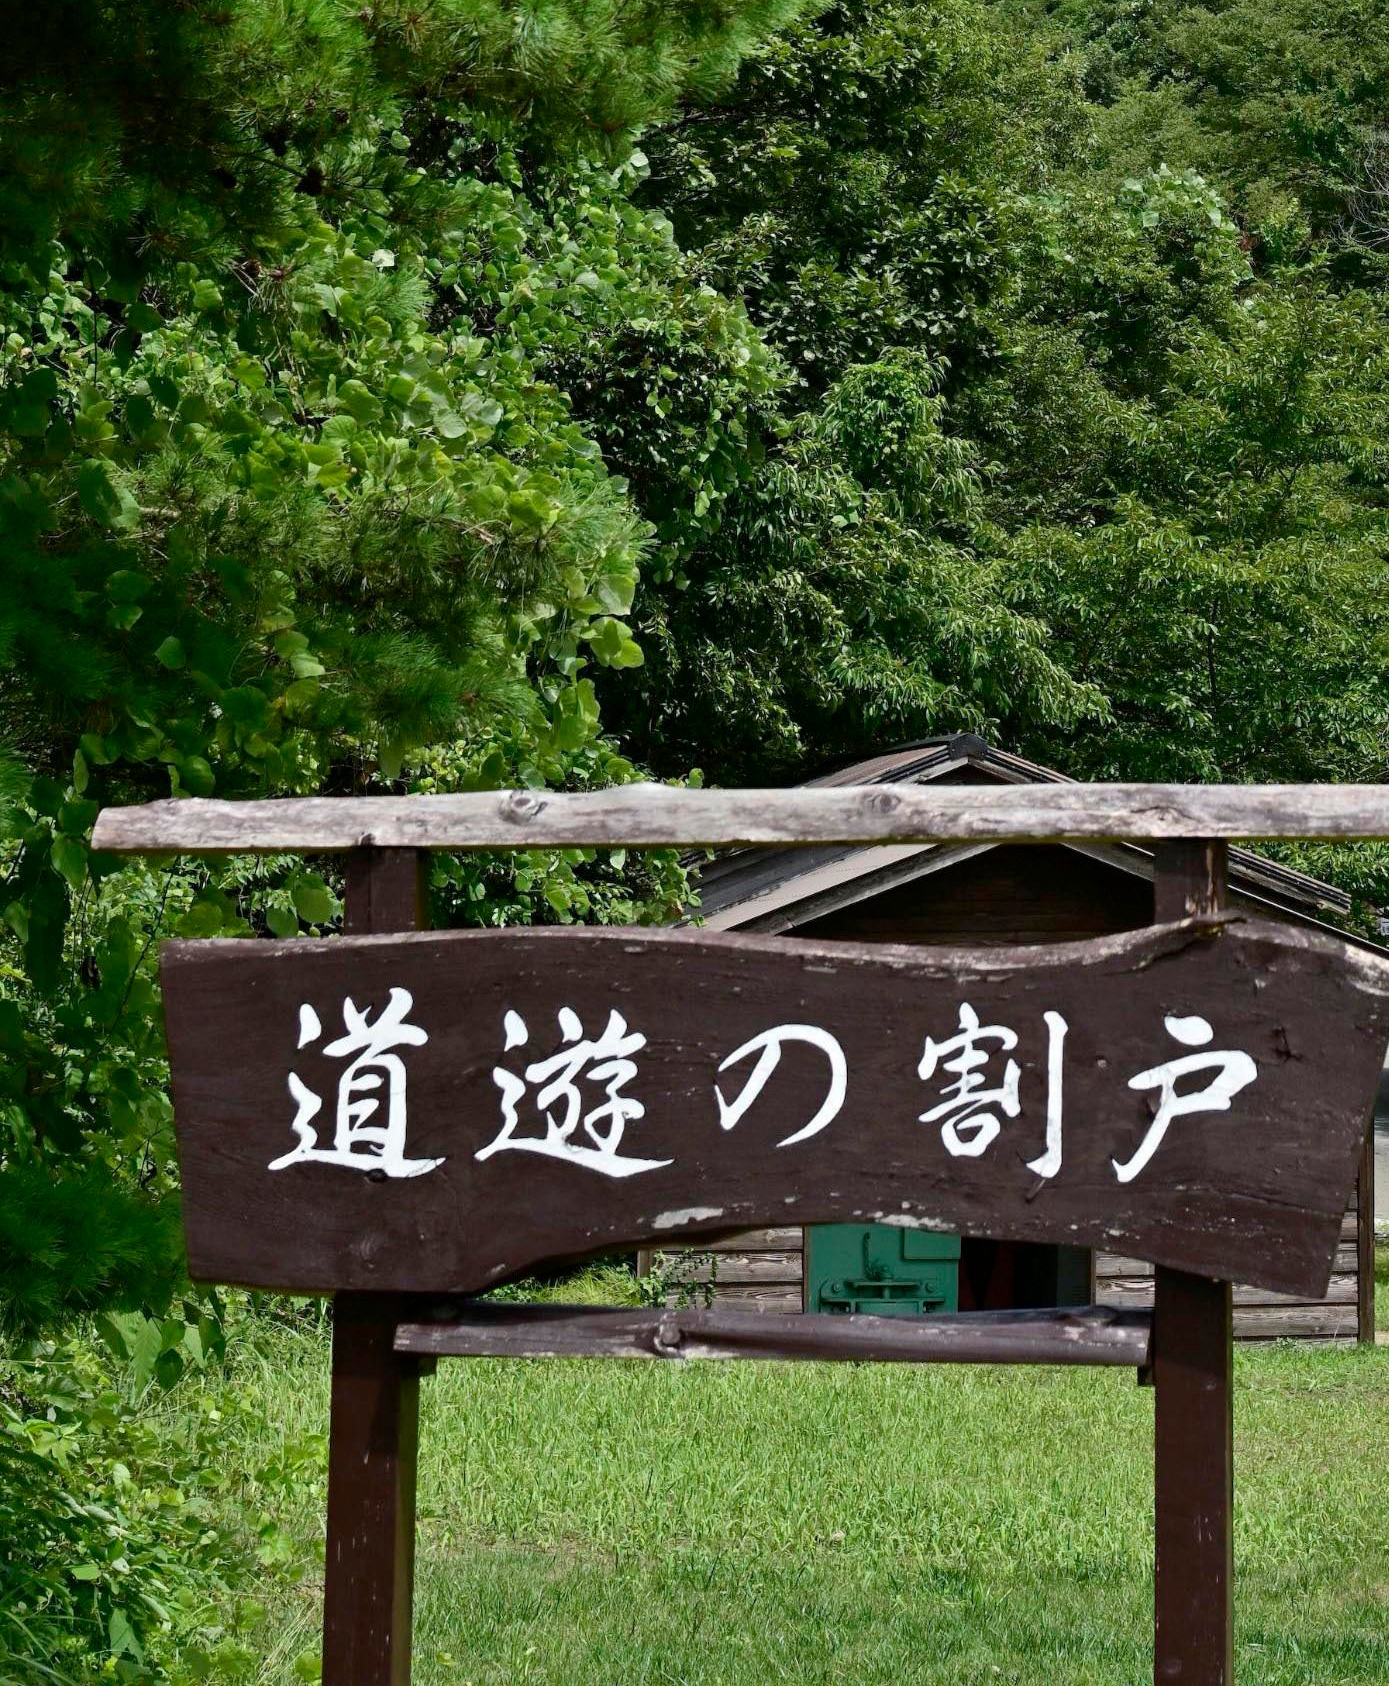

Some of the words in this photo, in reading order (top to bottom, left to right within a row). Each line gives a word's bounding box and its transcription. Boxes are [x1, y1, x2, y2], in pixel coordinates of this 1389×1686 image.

[266, 986, 1259, 1184] 道遊の割戸
